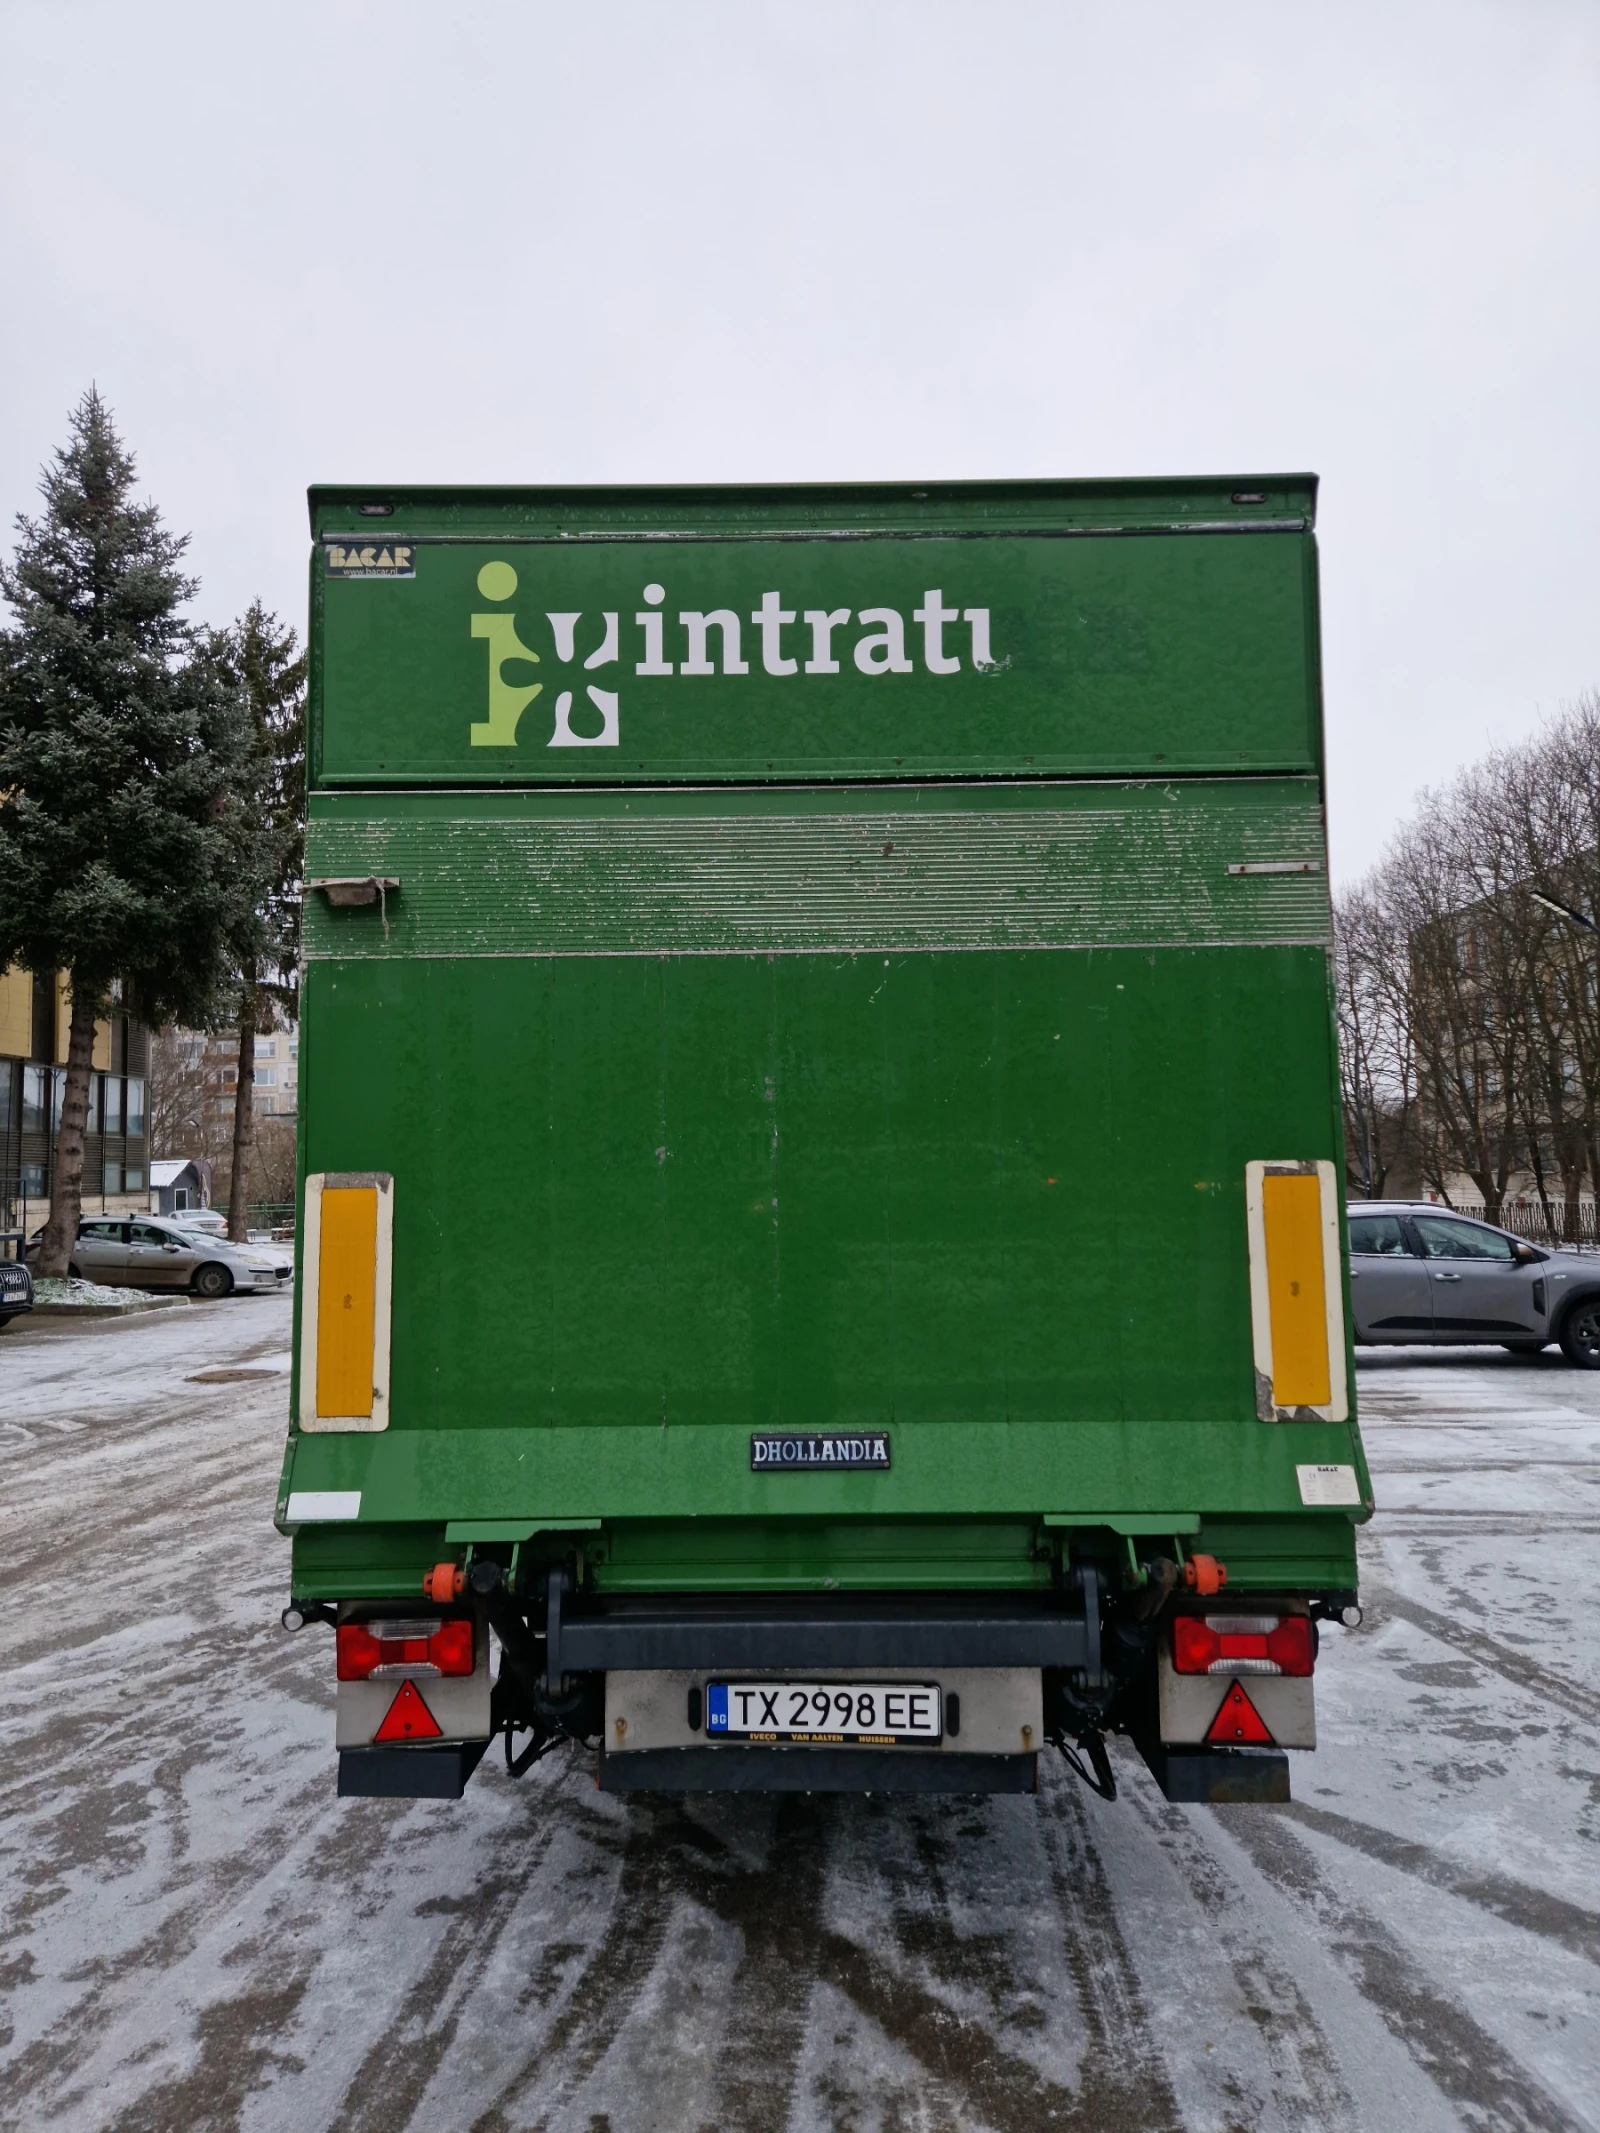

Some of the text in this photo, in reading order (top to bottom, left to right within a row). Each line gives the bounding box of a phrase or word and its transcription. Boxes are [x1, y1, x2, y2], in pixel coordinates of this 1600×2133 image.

[329, 547, 411, 567] BACAR
[343, 567, 398, 575] www.bacar.nl
[753, 1439, 888, 1462] DHOLLANDIA
[711, 1691, 931, 1730] BG TX 2998 EE
[749, 1733, 777, 1741] IVECO
[791, 1733, 810, 1741] VAN
[811, 1734, 843, 1742] AALTEN
